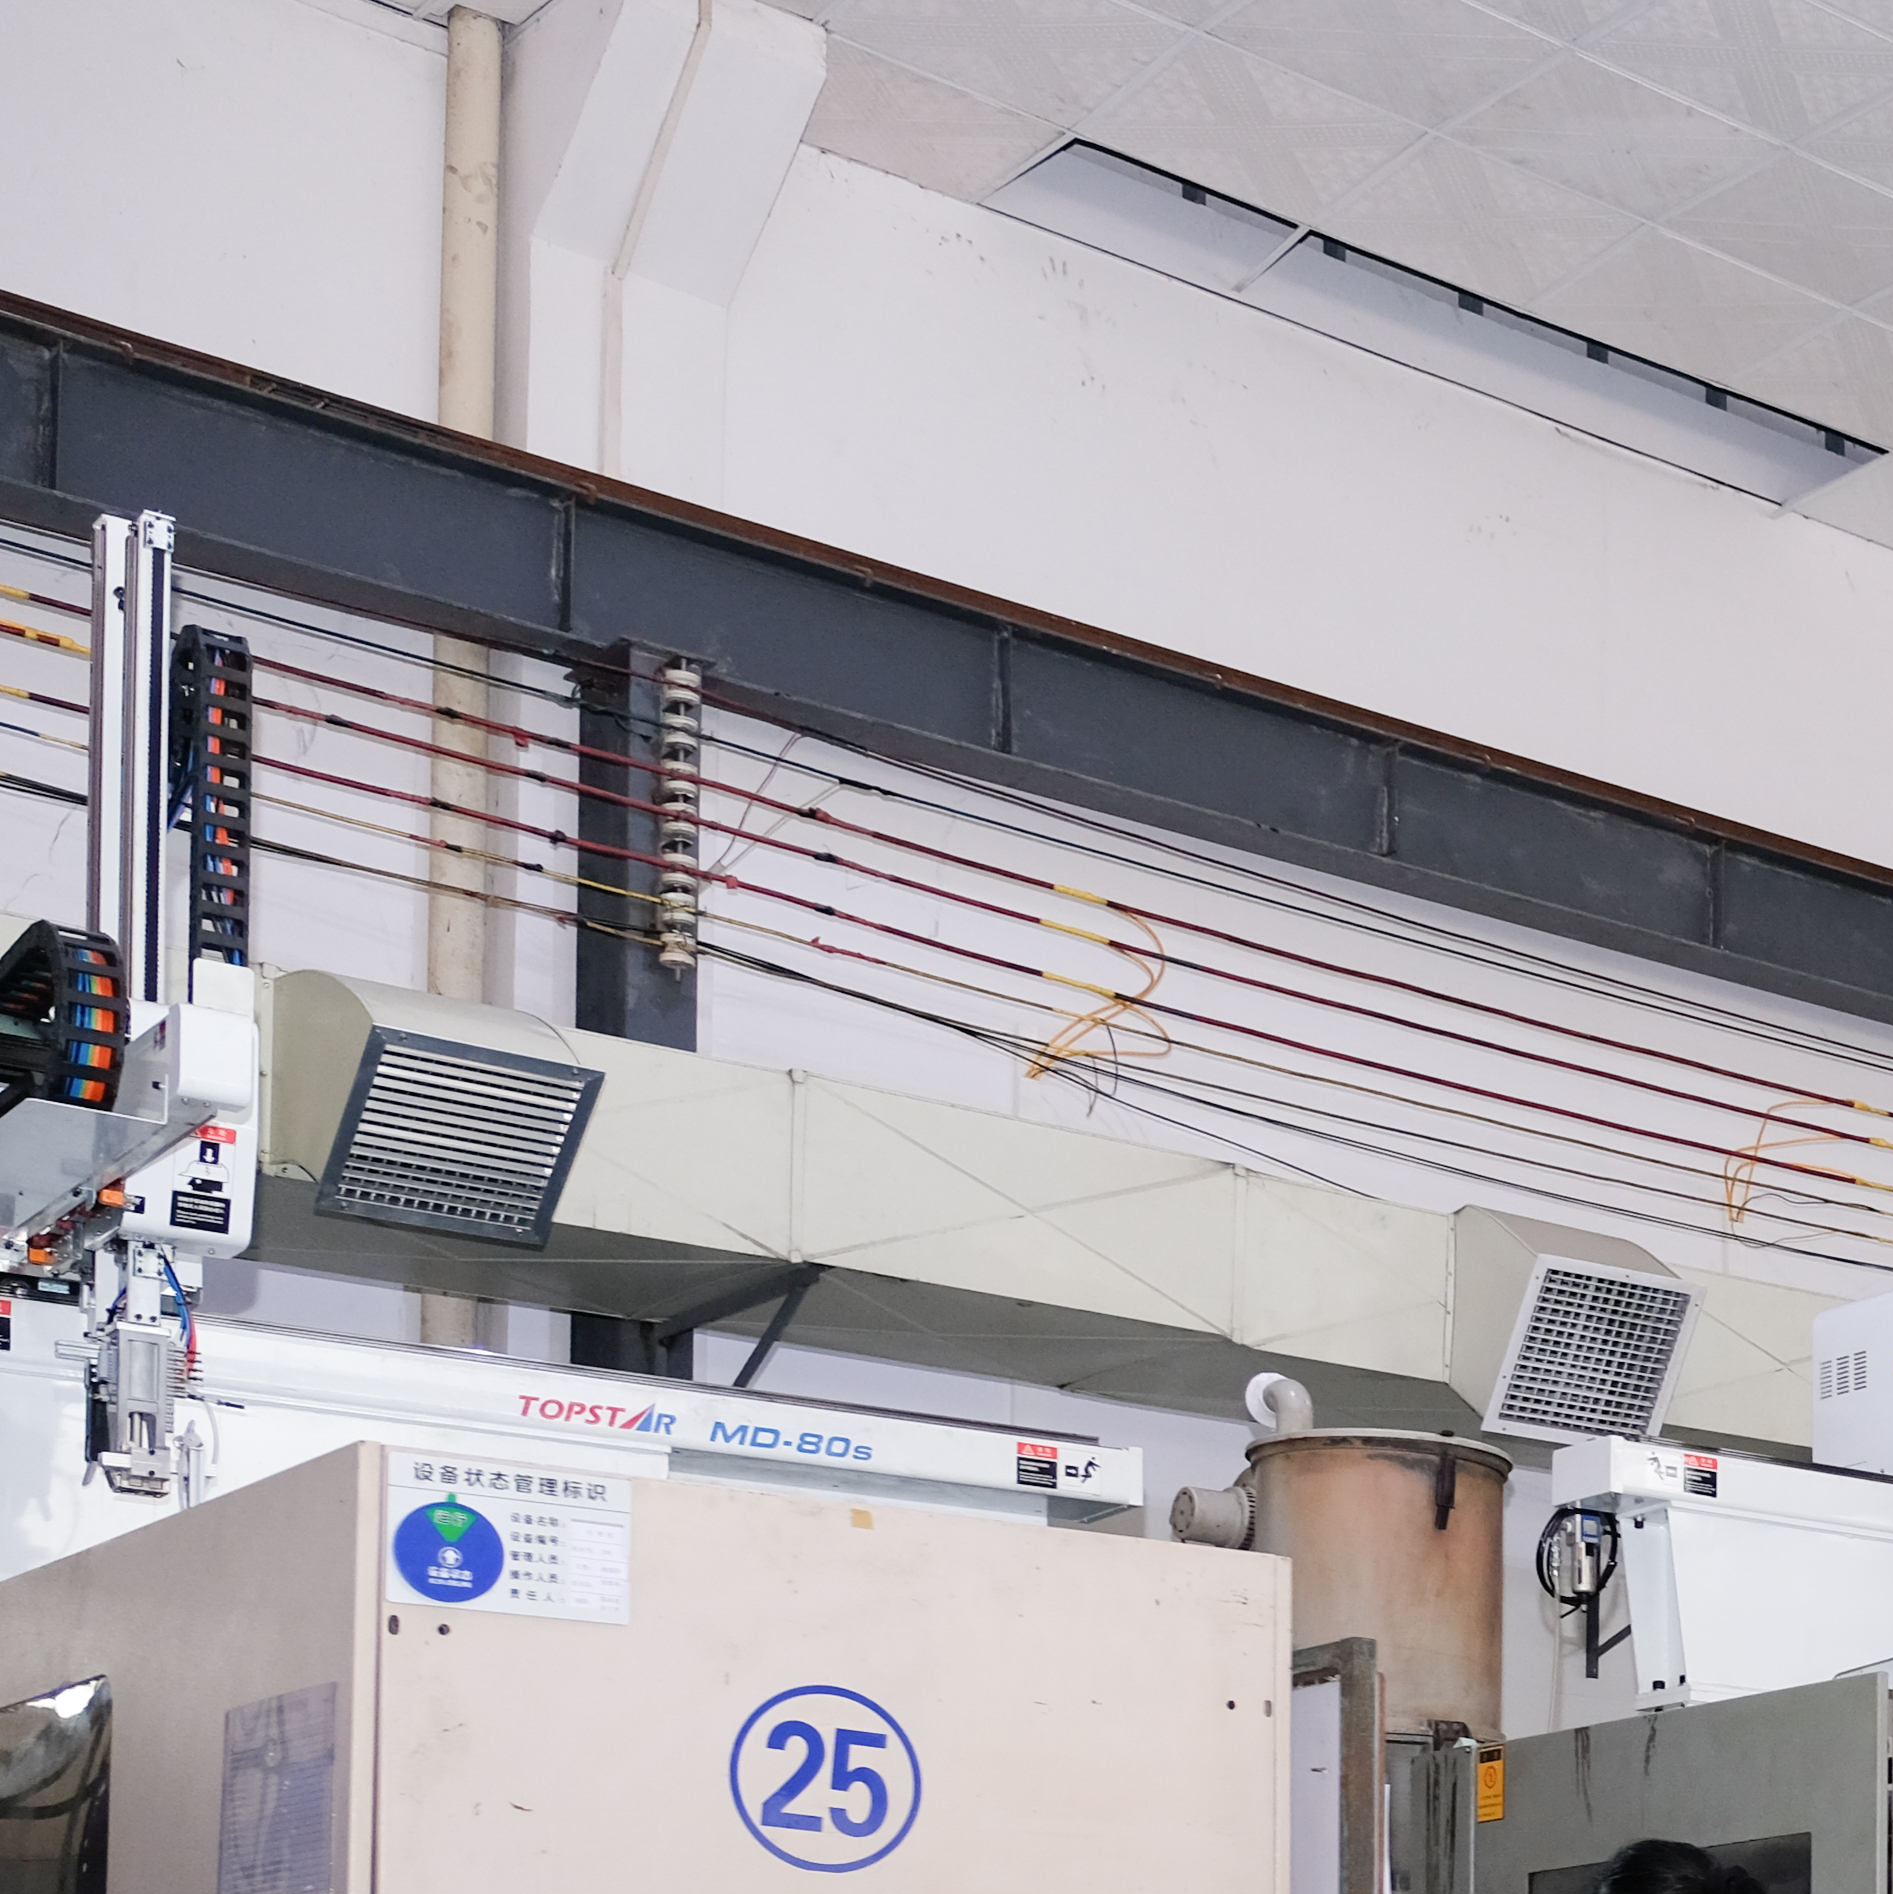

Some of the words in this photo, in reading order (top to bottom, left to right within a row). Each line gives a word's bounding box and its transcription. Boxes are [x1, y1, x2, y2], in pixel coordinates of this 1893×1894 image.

[517, 1394, 677, 1436] TOPSTAR
[710, 1420, 873, 1461] MD-80s
[413, 1461, 608, 1502] 设备状态管理标识
[760, 1719, 889, 1838] 25
